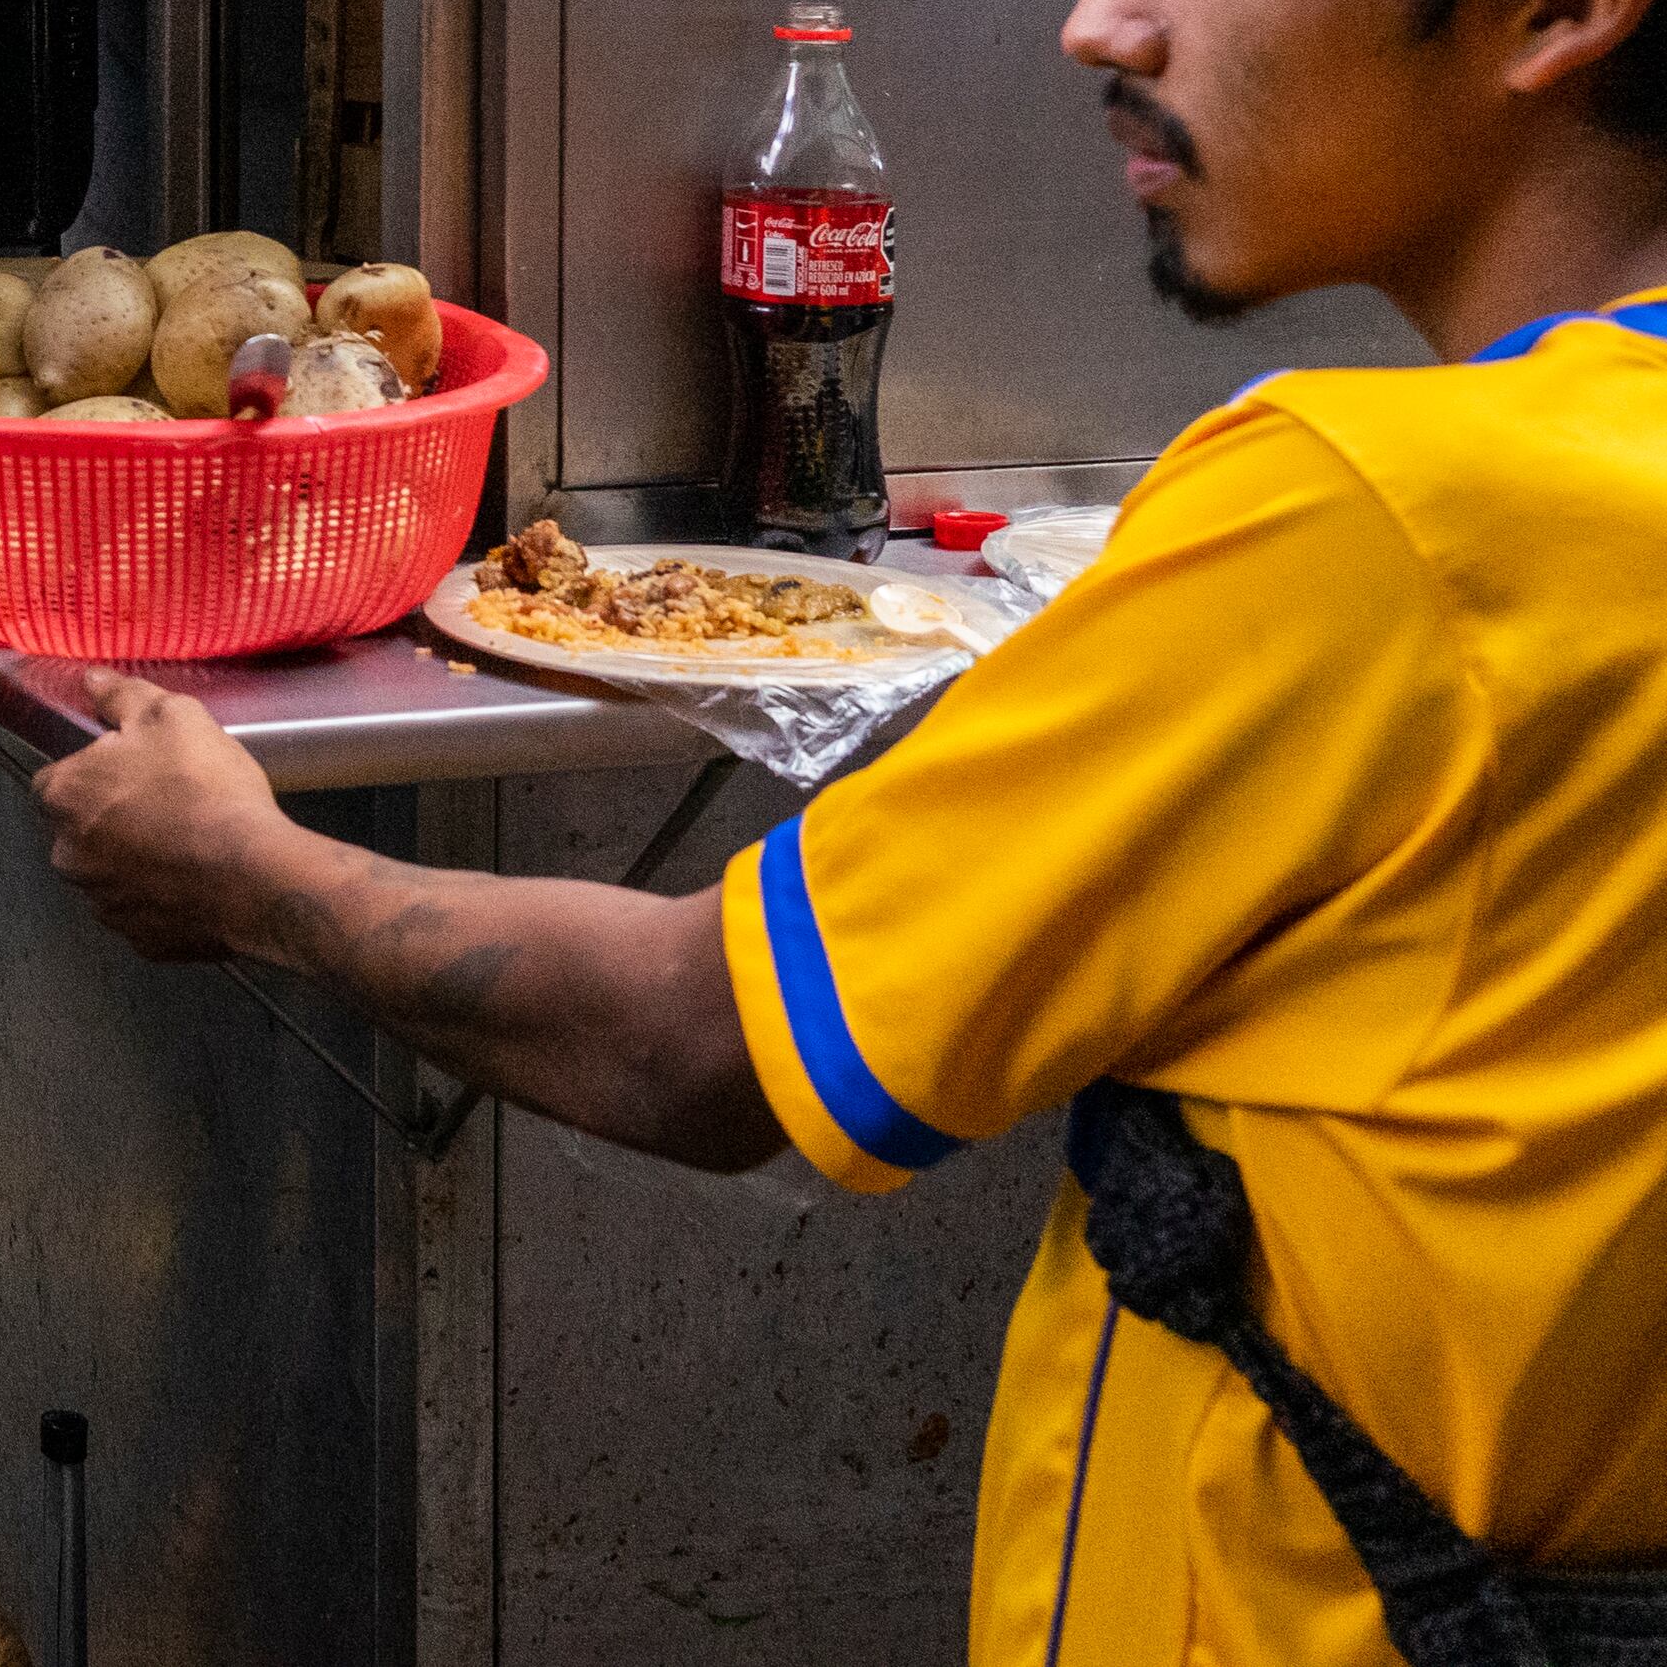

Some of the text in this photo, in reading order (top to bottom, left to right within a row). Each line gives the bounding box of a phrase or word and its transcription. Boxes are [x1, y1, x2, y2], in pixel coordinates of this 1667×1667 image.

[808, 260, 844, 272] REFRESCO
[808, 271, 844, 283] REDUCIDO
[844, 271, 854, 283] EN
[820, 284, 837, 296] 600
